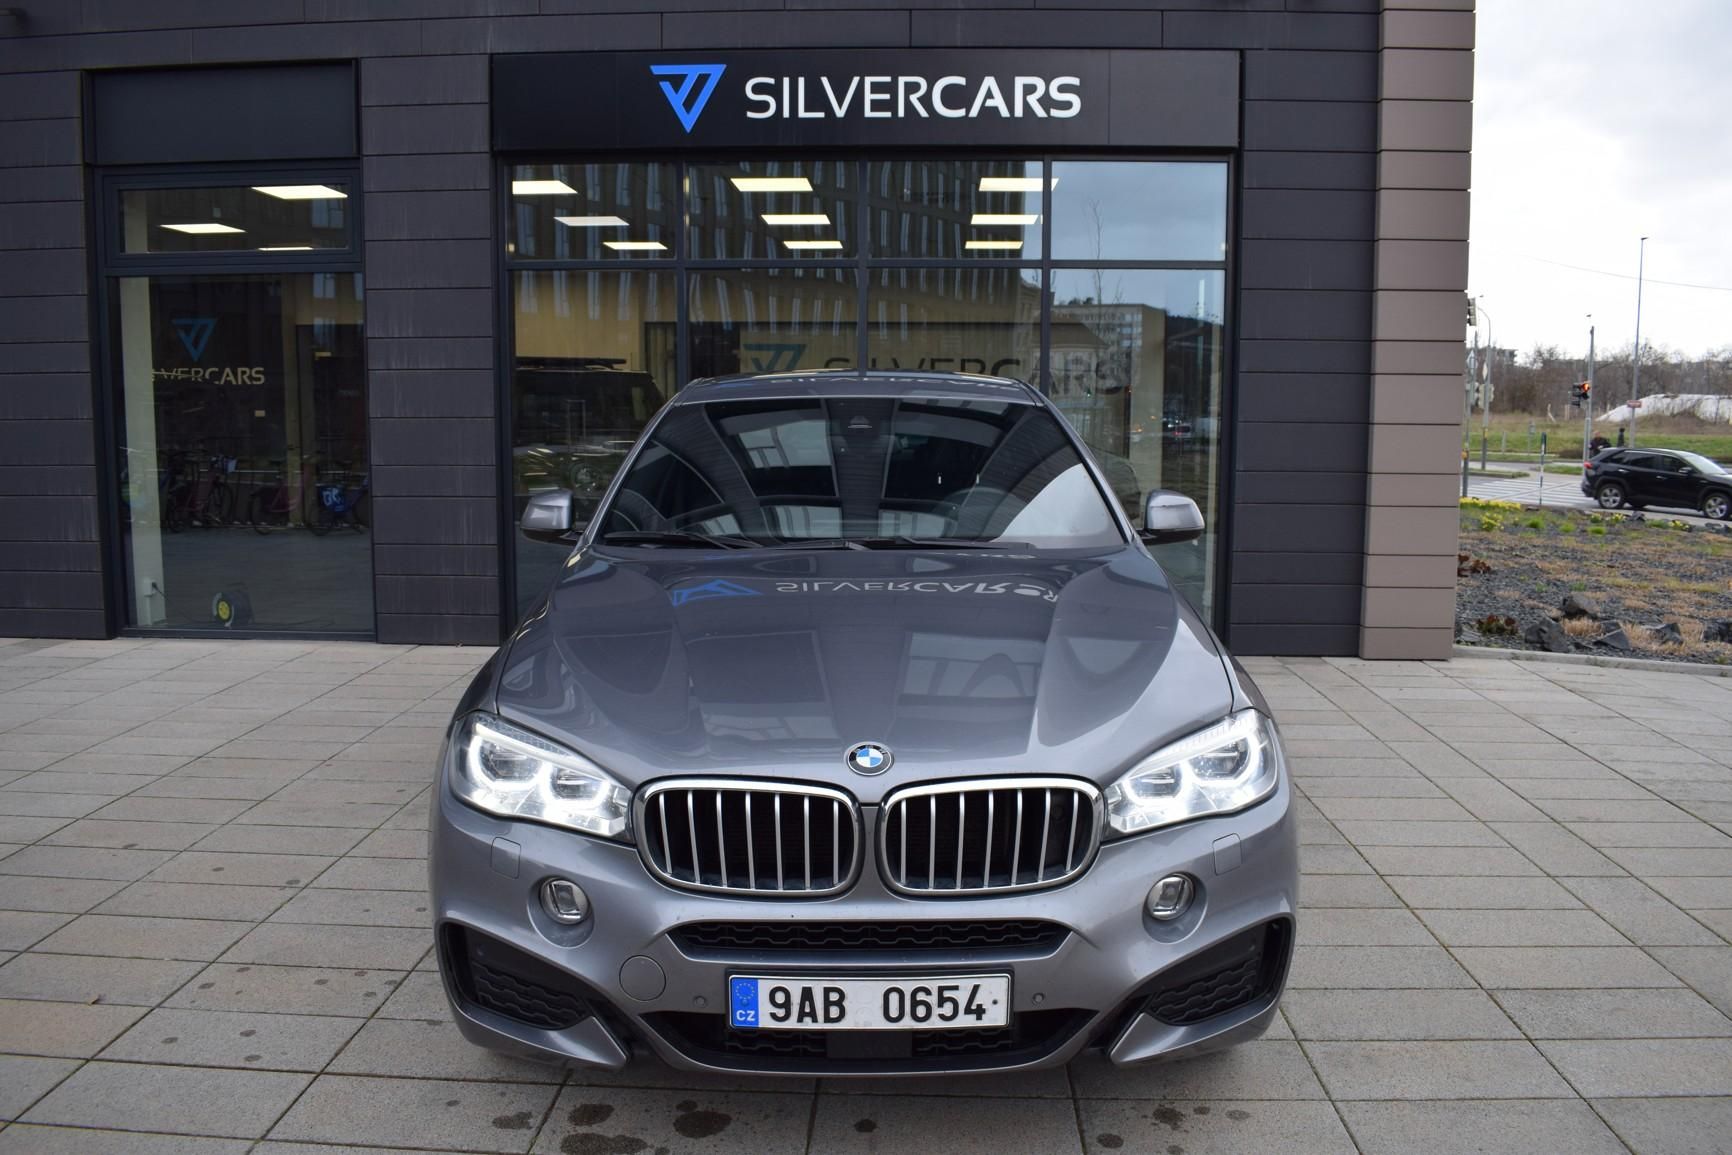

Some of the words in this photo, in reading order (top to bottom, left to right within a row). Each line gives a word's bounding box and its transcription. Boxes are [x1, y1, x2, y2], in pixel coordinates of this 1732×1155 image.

[745, 75, 1082, 119] SILVERCARS
[736, 1010, 756, 1022] CZ
[768, 985, 846, 1023] 9AB
[882, 984, 986, 1023] 0654
